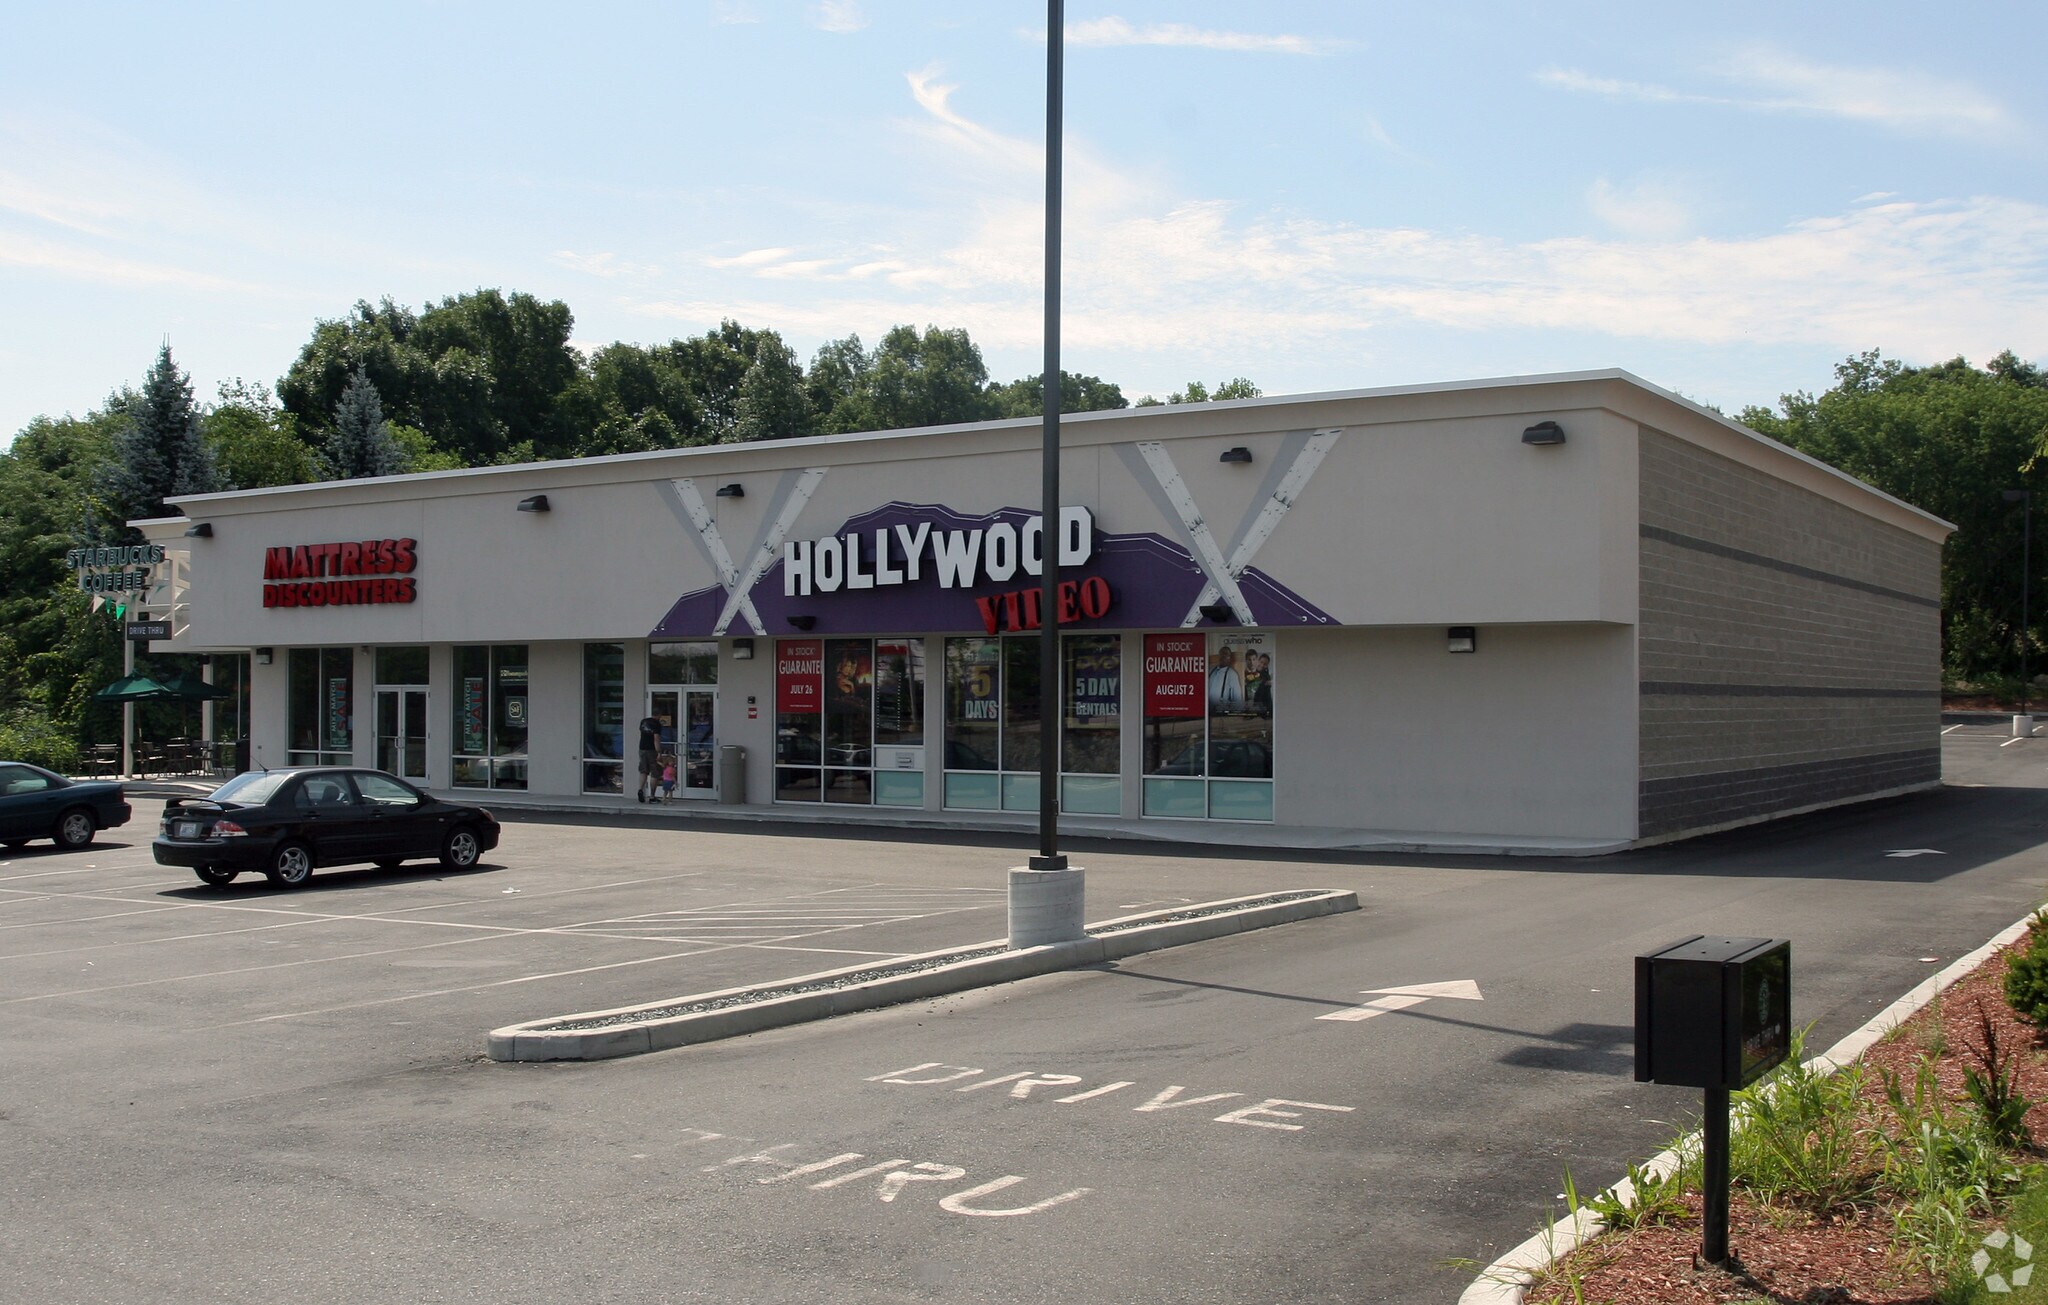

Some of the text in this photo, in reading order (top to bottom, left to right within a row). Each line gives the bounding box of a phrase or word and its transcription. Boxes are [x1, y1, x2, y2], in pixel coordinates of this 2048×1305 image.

[66, 544, 163, 569] STARBUCKS
[263, 538, 417, 579] MATTRESS
[784, 505, 1093, 596] HOLLYWOOD
[82, 571, 144, 593] COFFEE
[263, 577, 417, 608] DISCOUNTERS
[976, 576, 1111, 635] VIDEO
[128, 626, 164, 635] DRIVE THRU
[787, 647, 794, 656] IN
[1157, 642, 1164, 651] IN
[1146, 657, 1204, 673] GUARANTEE
[790, 684, 813, 695] JULY 26
[970, 665, 991, 697] 5
[1076, 677, 1118, 696] 5 DAY
[1155, 684, 1194, 696] AUGUST 2
[965, 700, 998, 719] DAYS
[862, 1062, 1357, 1131] DRIVE
